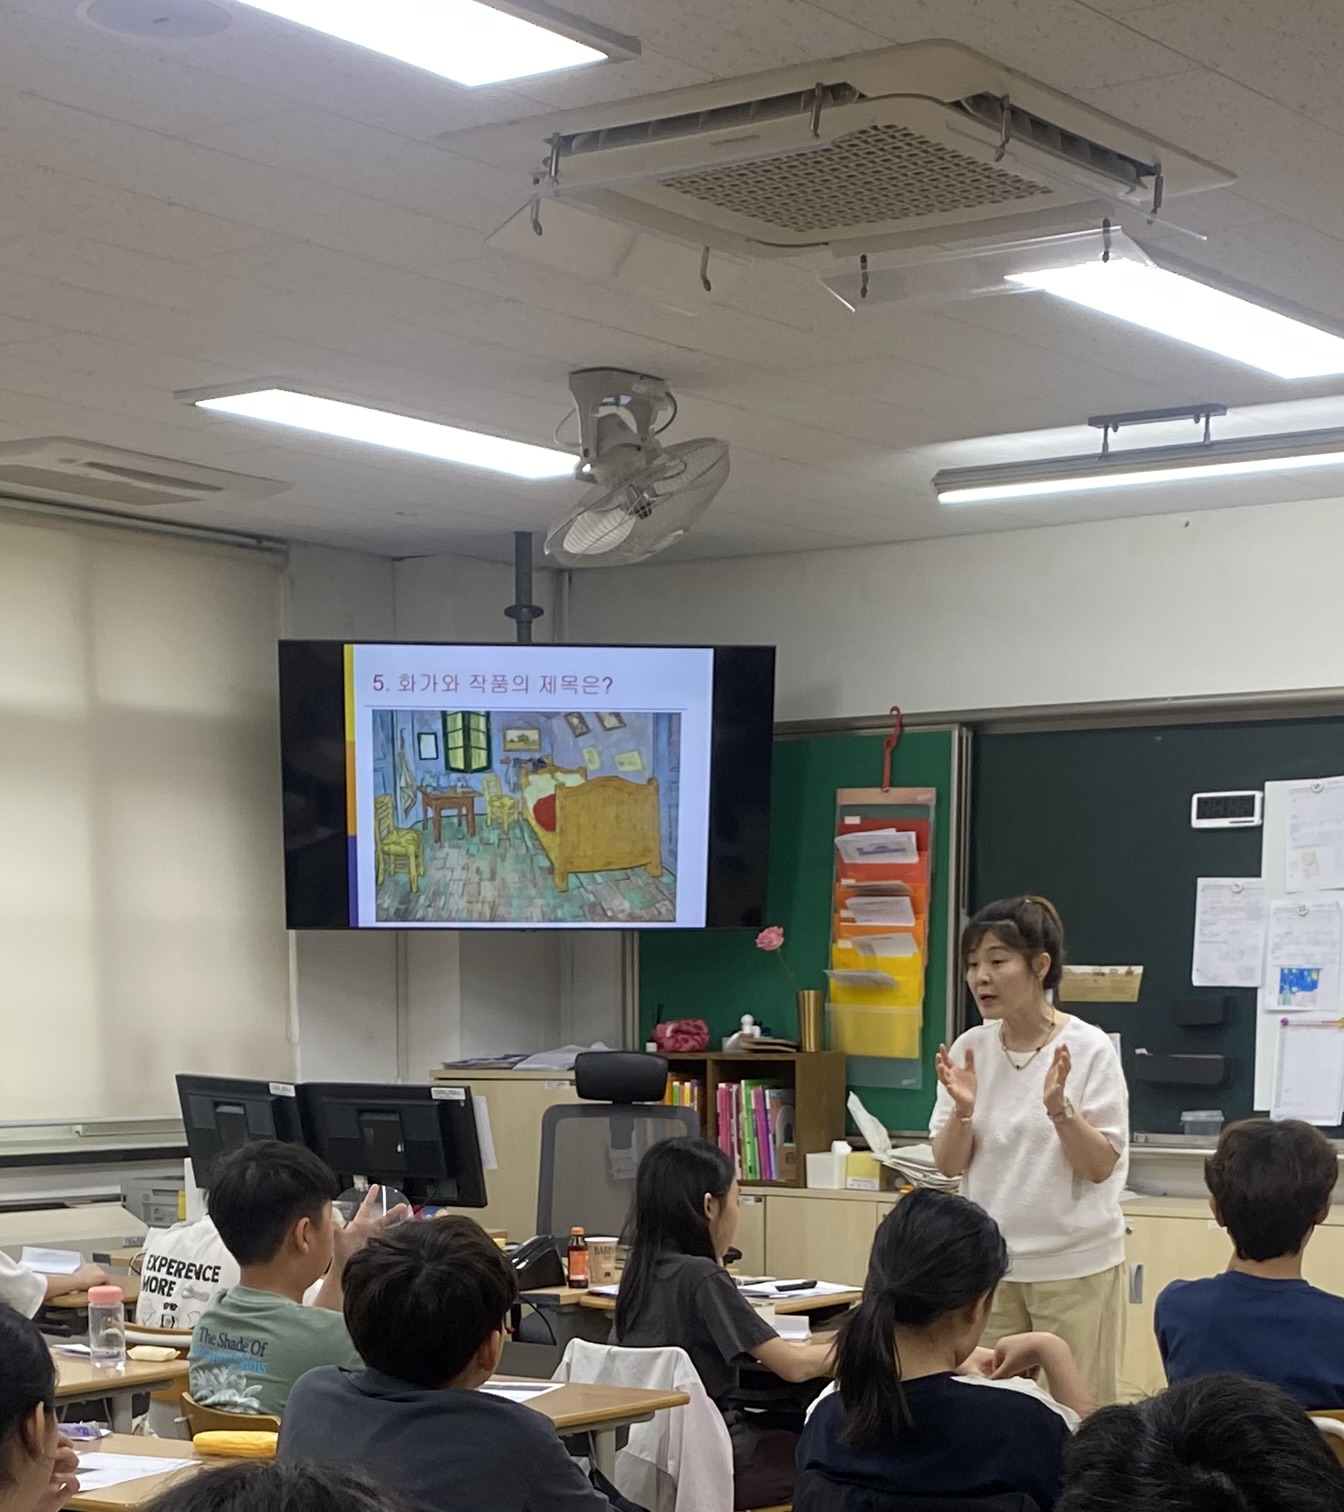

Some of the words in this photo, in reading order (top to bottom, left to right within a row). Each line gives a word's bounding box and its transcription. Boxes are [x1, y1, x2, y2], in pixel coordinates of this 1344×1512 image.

[372, 674, 391, 694] 5.
[397, 672, 460, 695] 화가와
[469, 673, 530, 695] 작품의
[539, 674, 614, 696] 제목은?
[199, 1326, 218, 1346] The
[217, 1330, 249, 1354] Shade
[250, 1340, 269, 1358] Of
